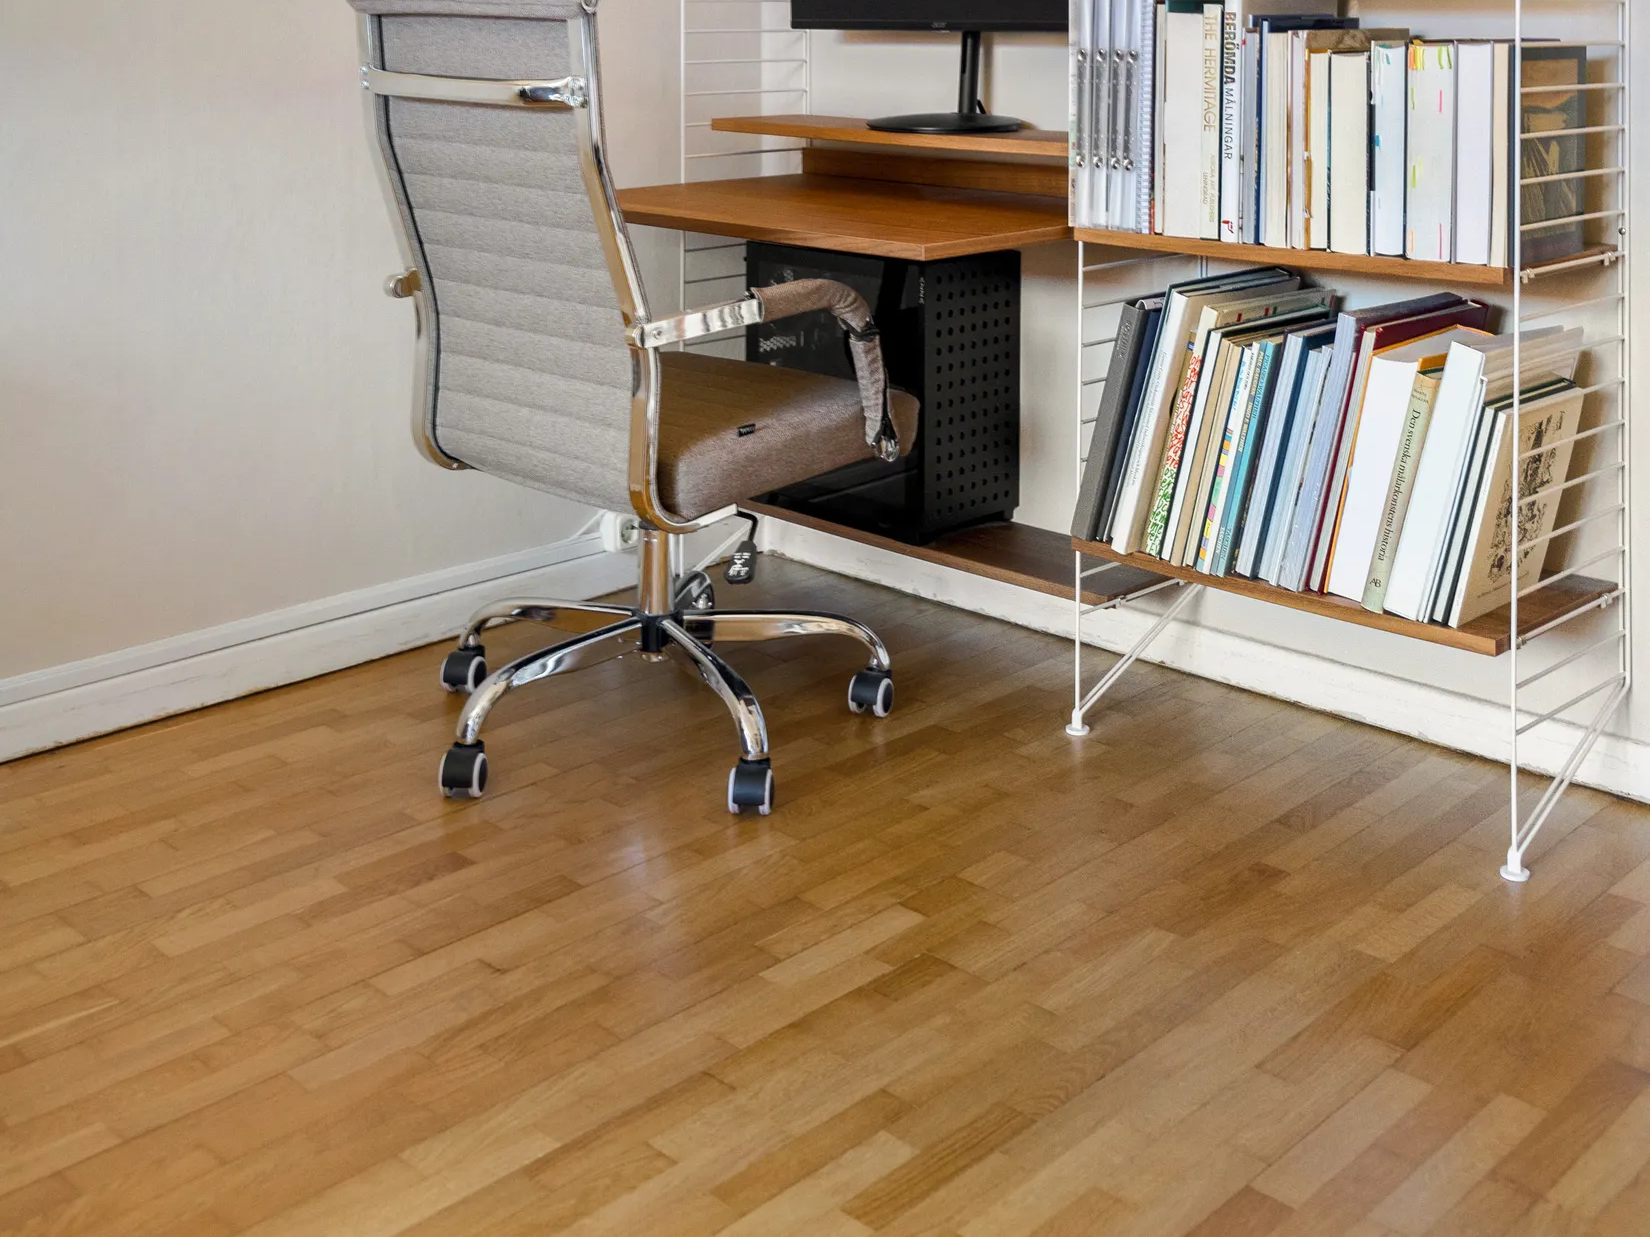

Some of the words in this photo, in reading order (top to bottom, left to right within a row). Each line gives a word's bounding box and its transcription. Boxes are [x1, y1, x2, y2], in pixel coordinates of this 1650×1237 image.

[1204, 14, 1218, 41] THE
[1224, 11, 1240, 85] BERÖMDA
[1203, 48, 1217, 132] HERMITAGE
[1223, 87, 1236, 160] MÅLNINGAR
[1256, 350, 1265, 366] PAUL
[1251, 368, 1261, 395] GAUGUIN
[1245, 402, 1253, 417] INGO
[1408, 409, 1421, 429] Den
[1238, 423, 1249, 452] WALTHER
[1400, 429, 1414, 465] svenska
[1384, 464, 1406, 527] målarkonstens
[1215, 526, 1225, 554] TASCHEN
[1377, 527, 1394, 562] historia
